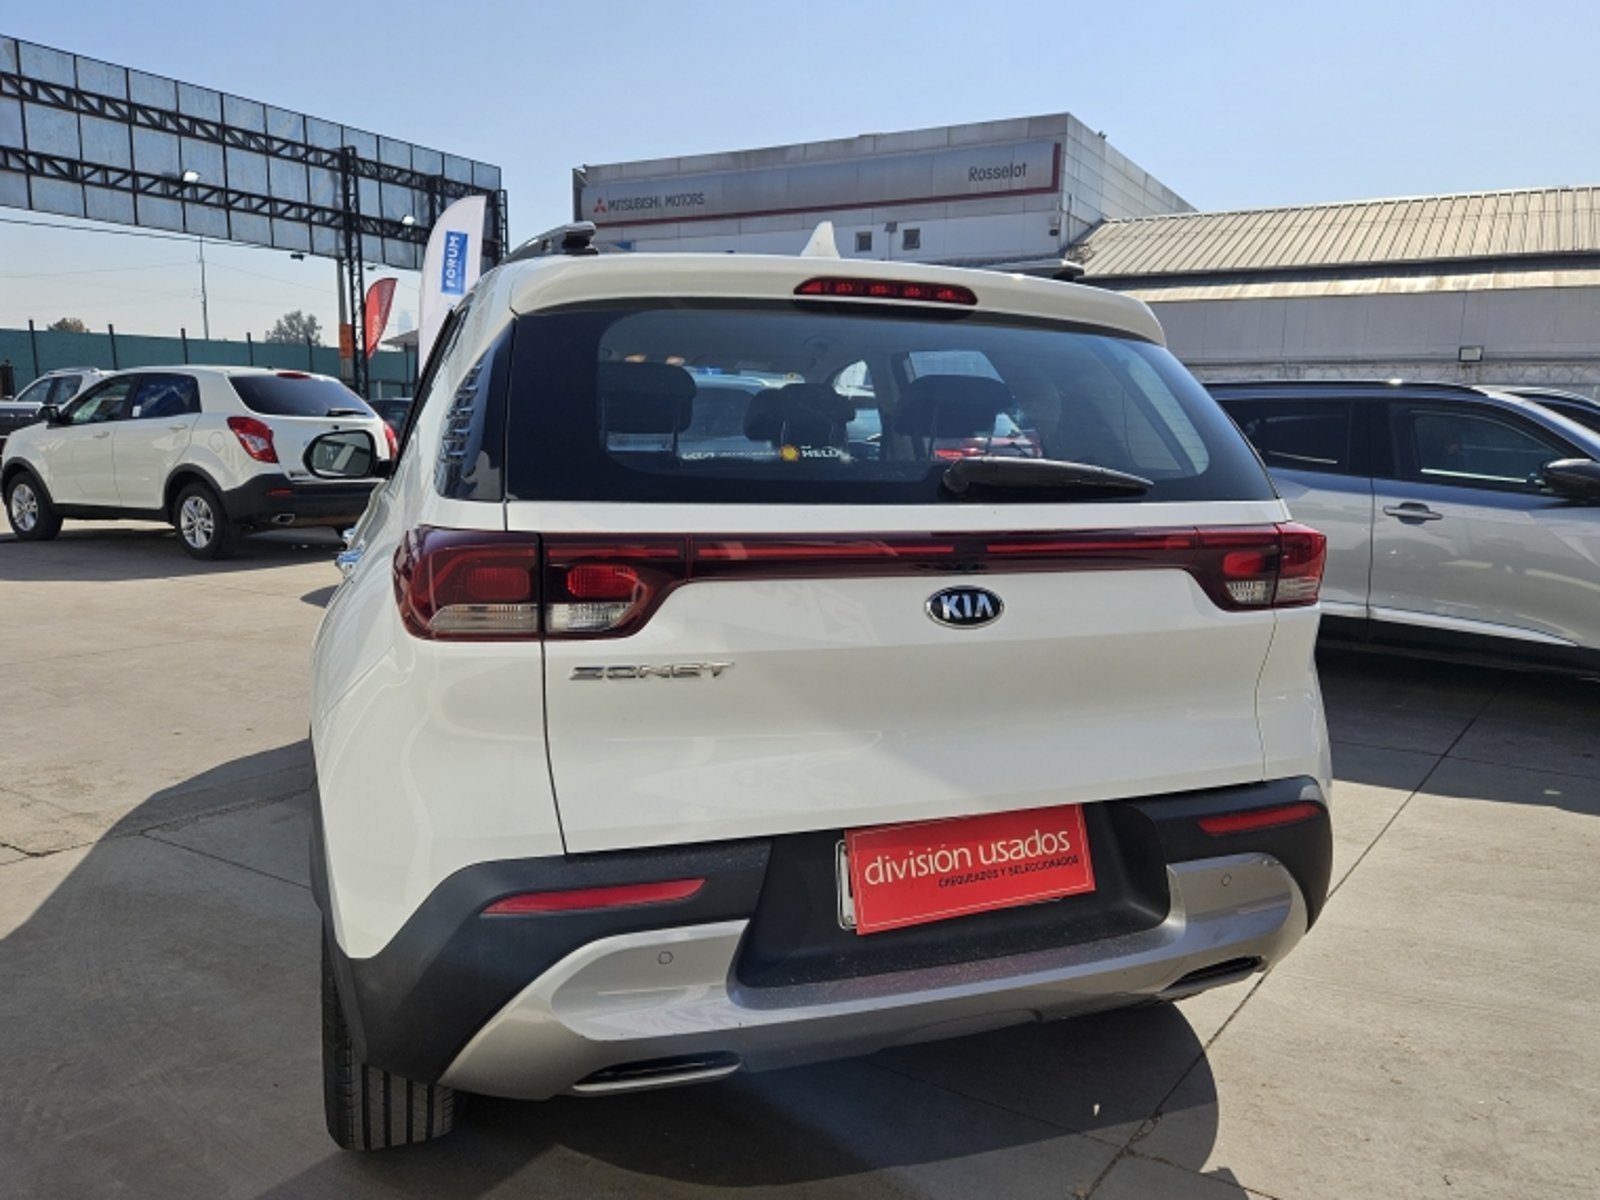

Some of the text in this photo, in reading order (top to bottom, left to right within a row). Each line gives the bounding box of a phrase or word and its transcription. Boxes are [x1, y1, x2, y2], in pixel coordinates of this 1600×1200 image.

[968, 161, 1027, 181] Rosselot
[608, 191, 705, 212] MITSUBISHI MOTORS
[445, 235, 460, 287] FORUM
[941, 593, 995, 619] KIA
[568, 660, 735, 681] SONET
[863, 829, 1070, 885] división usados
[938, 868, 999, 888] CHEQUEADOS
[1008, 854, 1079, 877] SELECCIONADOS
